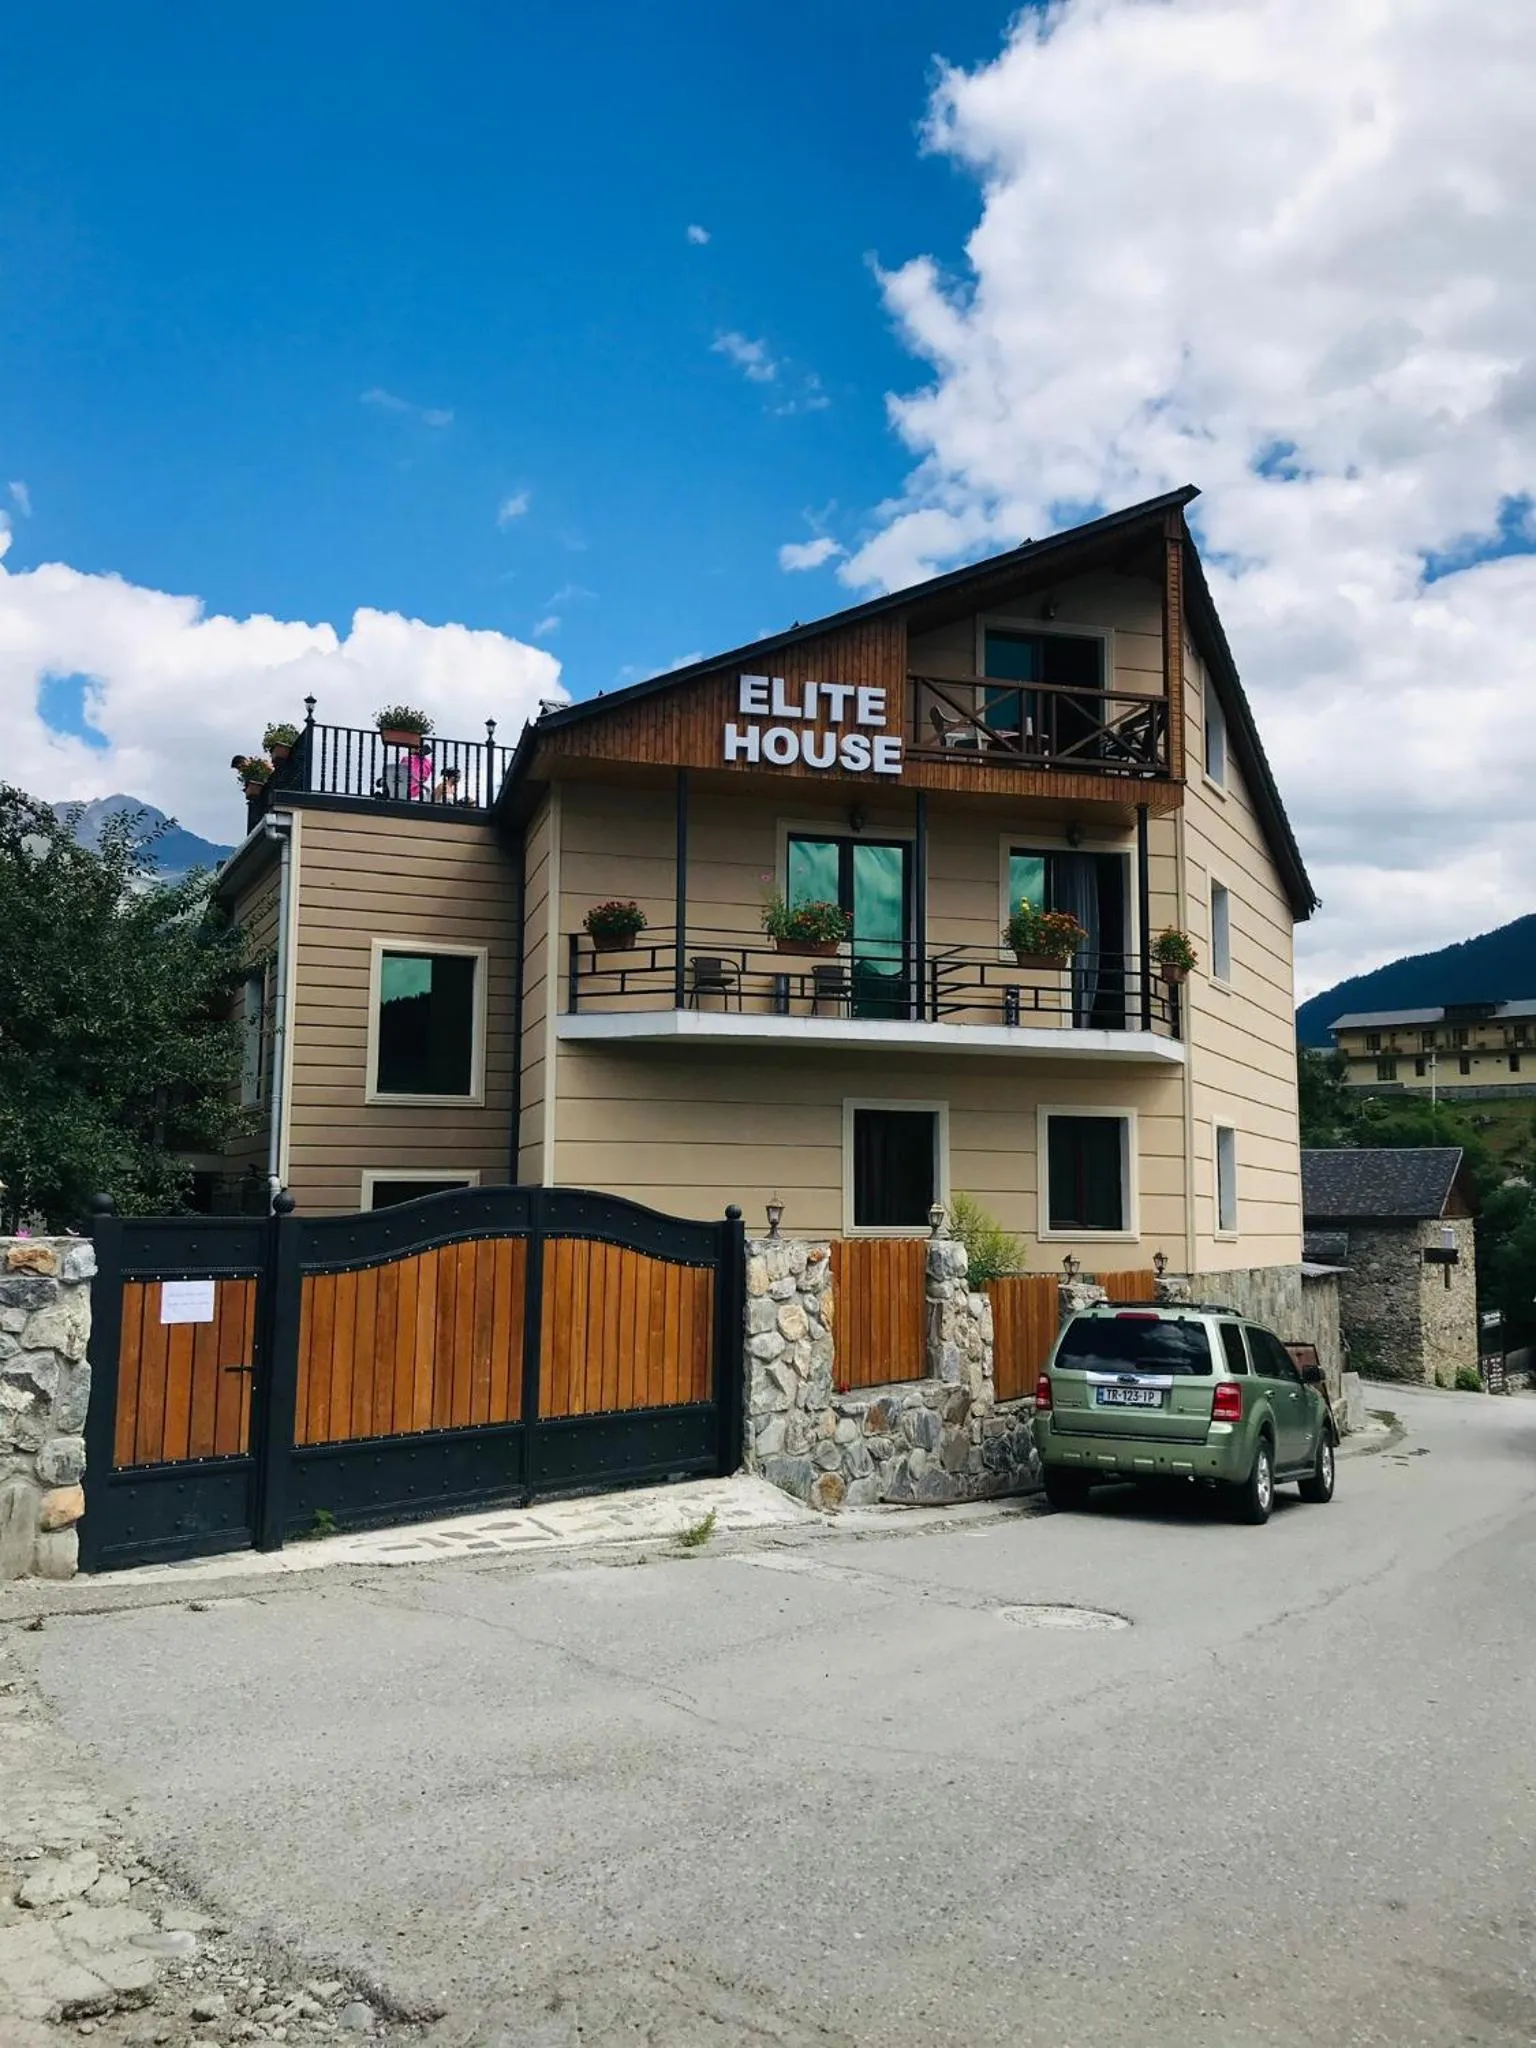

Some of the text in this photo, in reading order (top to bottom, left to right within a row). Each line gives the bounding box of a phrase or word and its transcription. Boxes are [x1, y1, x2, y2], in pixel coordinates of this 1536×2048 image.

[739, 674, 887, 726] ELITE
[724, 723, 903, 774] HOUSE
[1106, 1389, 1155, 1402] TR-123-IP
